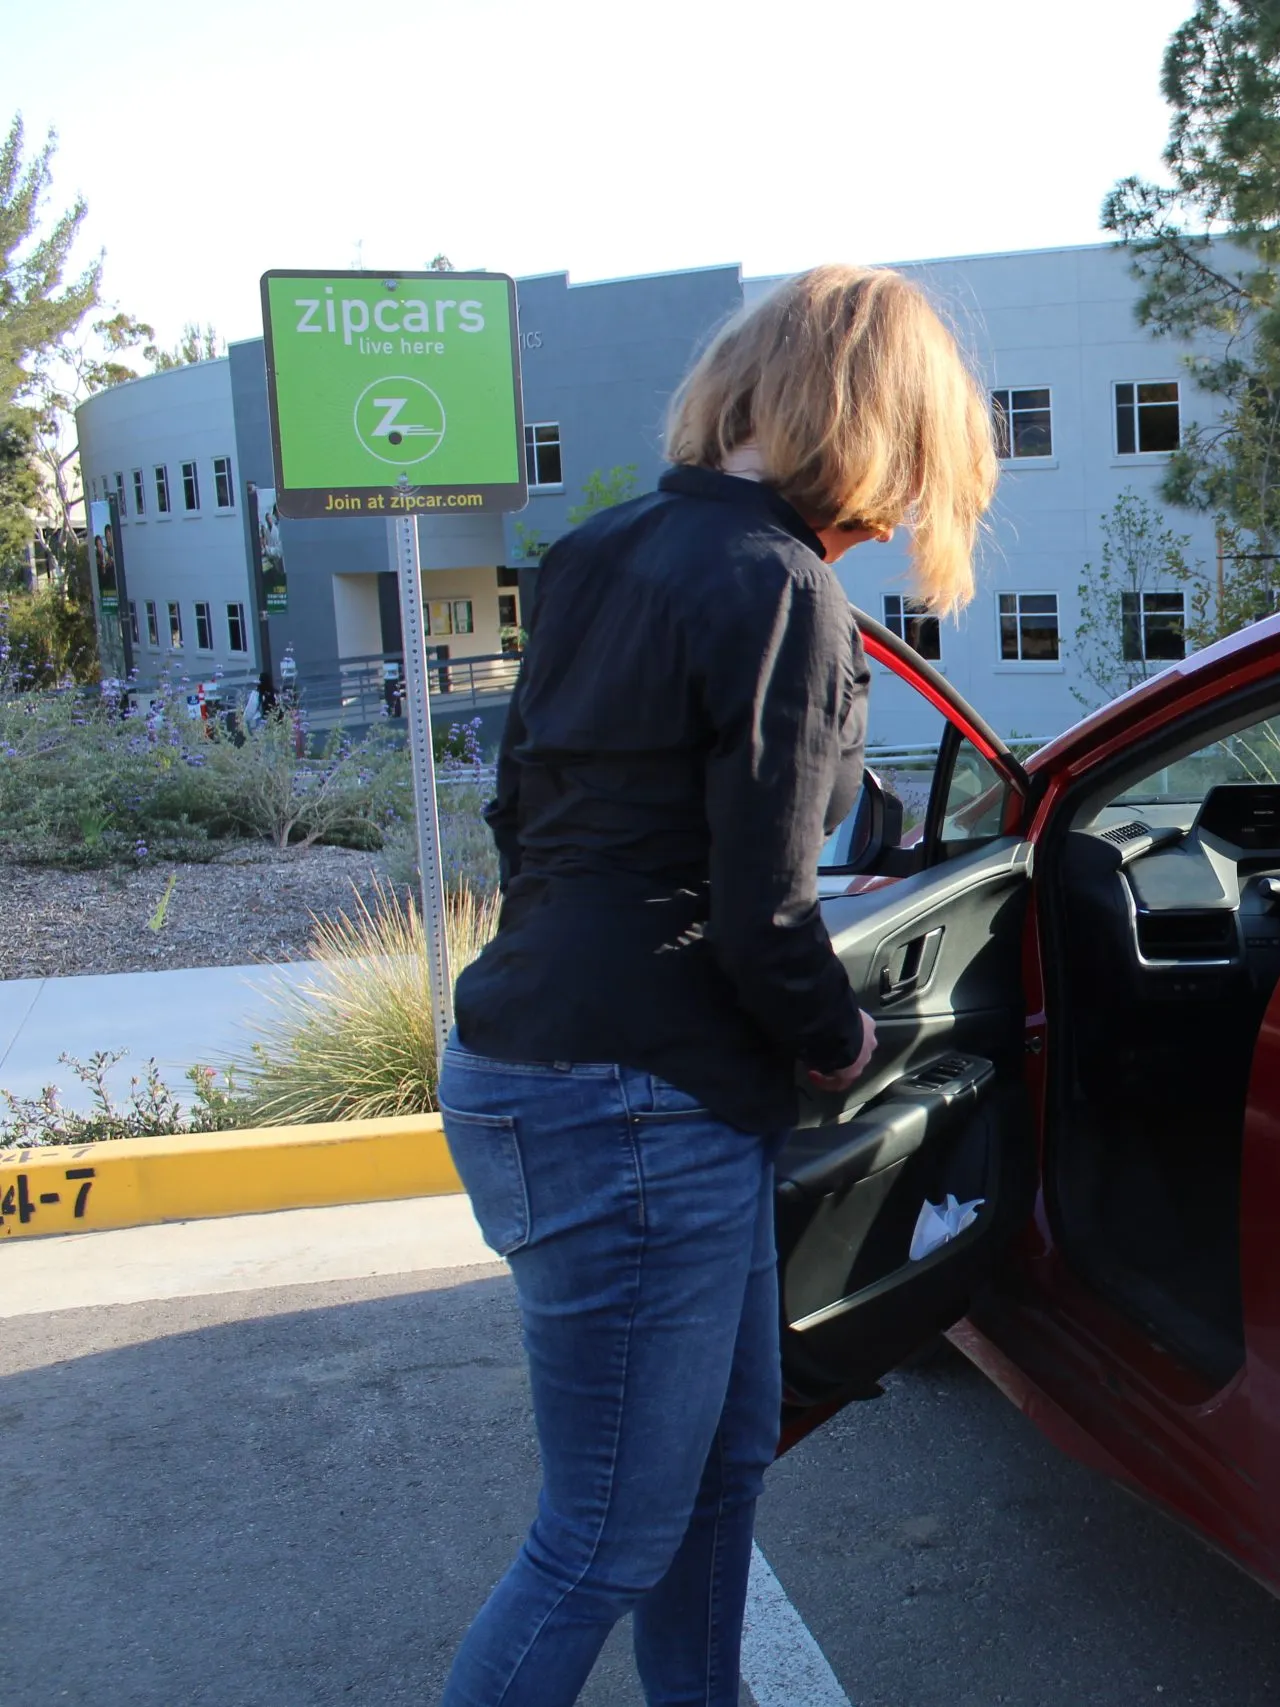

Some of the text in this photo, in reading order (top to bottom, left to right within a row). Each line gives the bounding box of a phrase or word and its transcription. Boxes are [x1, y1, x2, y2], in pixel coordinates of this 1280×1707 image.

[294, 286, 485, 346] zipcars
[359, 337, 445, 354] live here
[519, 331, 542, 349] ICS
[325, 492, 483, 511] Join at zipcar.com
[0, 1144, 97, 1164] 4-7
[0, 1167, 97, 1225] 4-7
